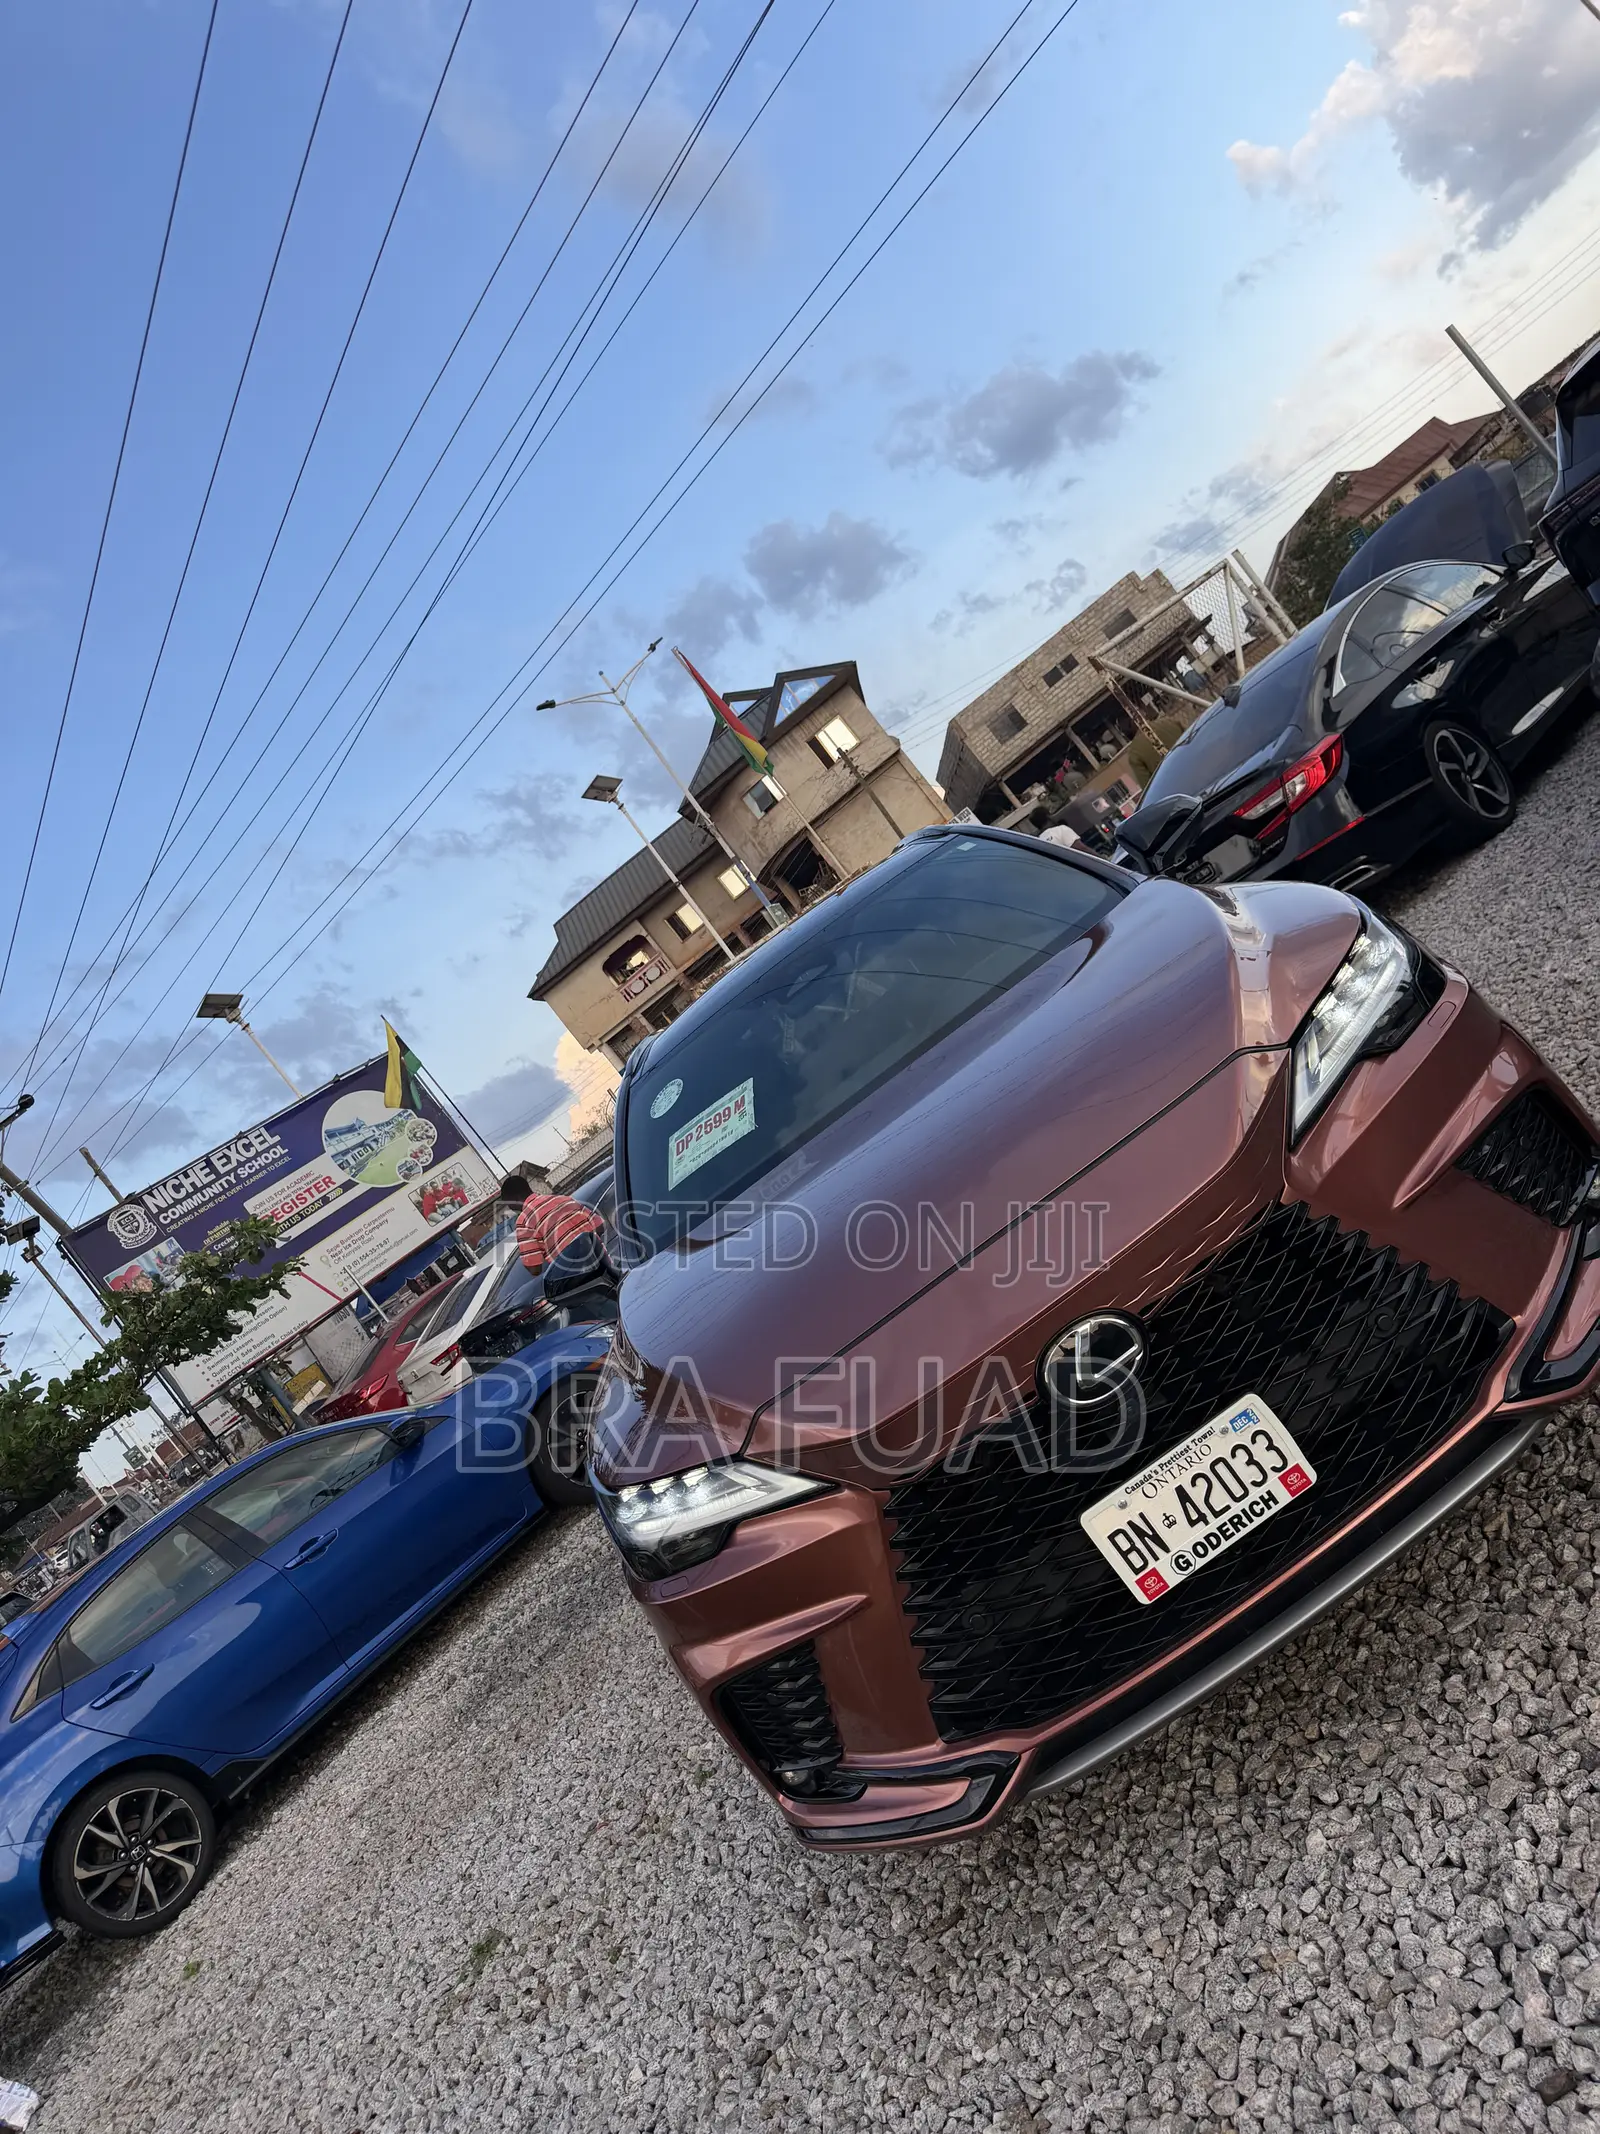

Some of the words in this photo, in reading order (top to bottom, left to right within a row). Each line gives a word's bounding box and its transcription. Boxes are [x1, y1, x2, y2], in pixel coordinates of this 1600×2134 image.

[675, 1134, 694, 1157] DP
[695, 1106, 732, 1143] 2599
[733, 1095, 746, 1115] M
[142, 1161, 217, 1214] NICHE
[210, 1127, 281, 1175] EXCEL
[159, 1173, 235, 1226] COMMUNITY
[237, 1145, 289, 1179] SCHOOL
[252, 1200, 266, 1212] JOIN
[266, 1195, 275, 1203] US
[274, 1188, 286, 1198] FOR
[286, 1170, 315, 1190] ACADEMIC
[167, 1214, 195, 1234] CREATING
[198, 1201, 216, 1215] NICHE
[215, 1194, 228, 1205] FOR
[226, 1184, 244, 1198] EVERY
[243, 1169, 268, 1187] LEARNER
[267, 1165, 276, 1173] TO
[275, 1155, 293, 1168] EXCEL
[290, 1214, 302, 1225] US
[301, 1199, 323, 1217] TODAY
[121, 1215, 134, 1226] ECS
[207, 1219, 231, 1236] Available
[330, 1248, 344, 1260] Near
[364, 1218, 389, 1237] Company
[361, 1235, 375, 1247] Road
[213, 1235, 236, 1251] Creche
[207, 1351, 234, 1372] Swimming
[233, 1337, 254, 1354] Lessons
[212, 1363, 231, 1379] Quality
[230, 1356, 241, 1366] and
[241, 1348, 253, 1358] Safe
[252, 1333, 276, 1350] Boarding
[216, 1375, 228, 1385] 24/7
[227, 1364, 243, 1377] CCTV
[242, 1344, 273, 1367] Surveillance
[272, 1338, 281, 1347] For
[280, 1329, 294, 1341] Child
[293, 1319, 309, 1332] Safety
[1233, 1416, 1249, 1430] DEC
[1124, 1468, 1159, 1496] Canada's
[1157, 1445, 1193, 1471] Prettiest
[1190, 1426, 1217, 1451] Town!
[1141, 1443, 1213, 1500] ONTARIO
[1107, 1511, 1172, 1577] BN
[1174, 1429, 1289, 1529] 42033
[1289, 1477, 1308, 1492] TOYOTA
[1172, 1489, 1280, 1573] GODERICH
[1147, 1582, 1164, 1596] TOYOTA
